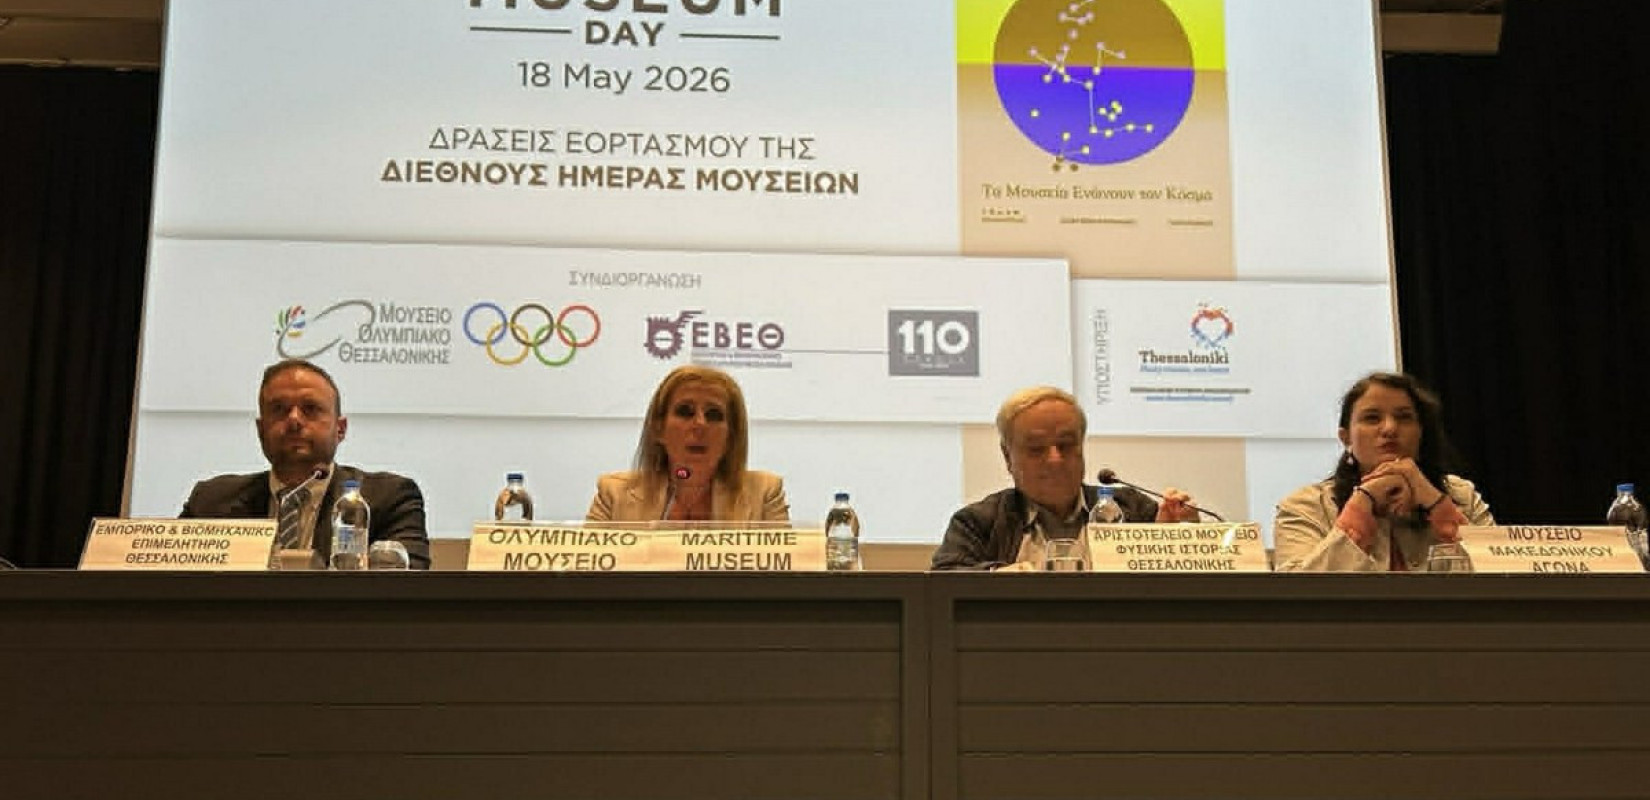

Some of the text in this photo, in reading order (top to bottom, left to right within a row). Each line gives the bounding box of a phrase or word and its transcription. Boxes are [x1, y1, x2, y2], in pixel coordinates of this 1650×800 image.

[585, 20, 664, 46] DAY
[517, 63, 731, 94] 18 May 2026
[428, 129, 816, 160] ΔΡΑΣΕΙΣ ΕΟΡΤΑΣΜΟΥ ΤΗΣ
[380, 161, 859, 195] ΔΙΕΘΝΟΥΣ ΗΜΕΡΑΣ ΜΟΥΣΕΙΩΝ
[568, 271, 702, 289] ΣΥΝΔΙΟΡΓΑΝΩΣΗ
[691, 321, 785, 350] ΕΒΕΘ
[898, 320, 969, 354] 110
[1138, 350, 1230, 364] Thessaloniki
[95, 524, 166, 535] ΕΜΠΟΡΙΚΟ
[168, 526, 178, 534] &
[1094, 528, 1258, 541] ΑΡΙΣΤΟΤΕΛΕΙΟ ΜΟΥΕΙΟ
[1508, 527, 1582, 541] ΜΟΥΣΕΙΟ
[131, 538, 231, 549] ΕΠΙΜΕΛΗΤΗΡΙΟ
[488, 529, 638, 547] ΟΛΥΜΠΙΑΚΟ
[681, 532, 798, 546] MARITIME
[1116, 544, 1176, 554] ΦΥΣΙΚΗΣ
[1489, 546, 1613, 557] ΜΑΚΕΔΟΝΙΚΟΥ
[125, 552, 230, 564] ΘΕΣΣΑΛΟΝΙΚΗΣ
[503, 552, 617, 571] ΜΟΥΣΕΙΟ
[685, 552, 792, 571] MUSEUM
[1128, 559, 1236, 571] ΘΕΣΣΑΛΟΝΙΚΗΣ
